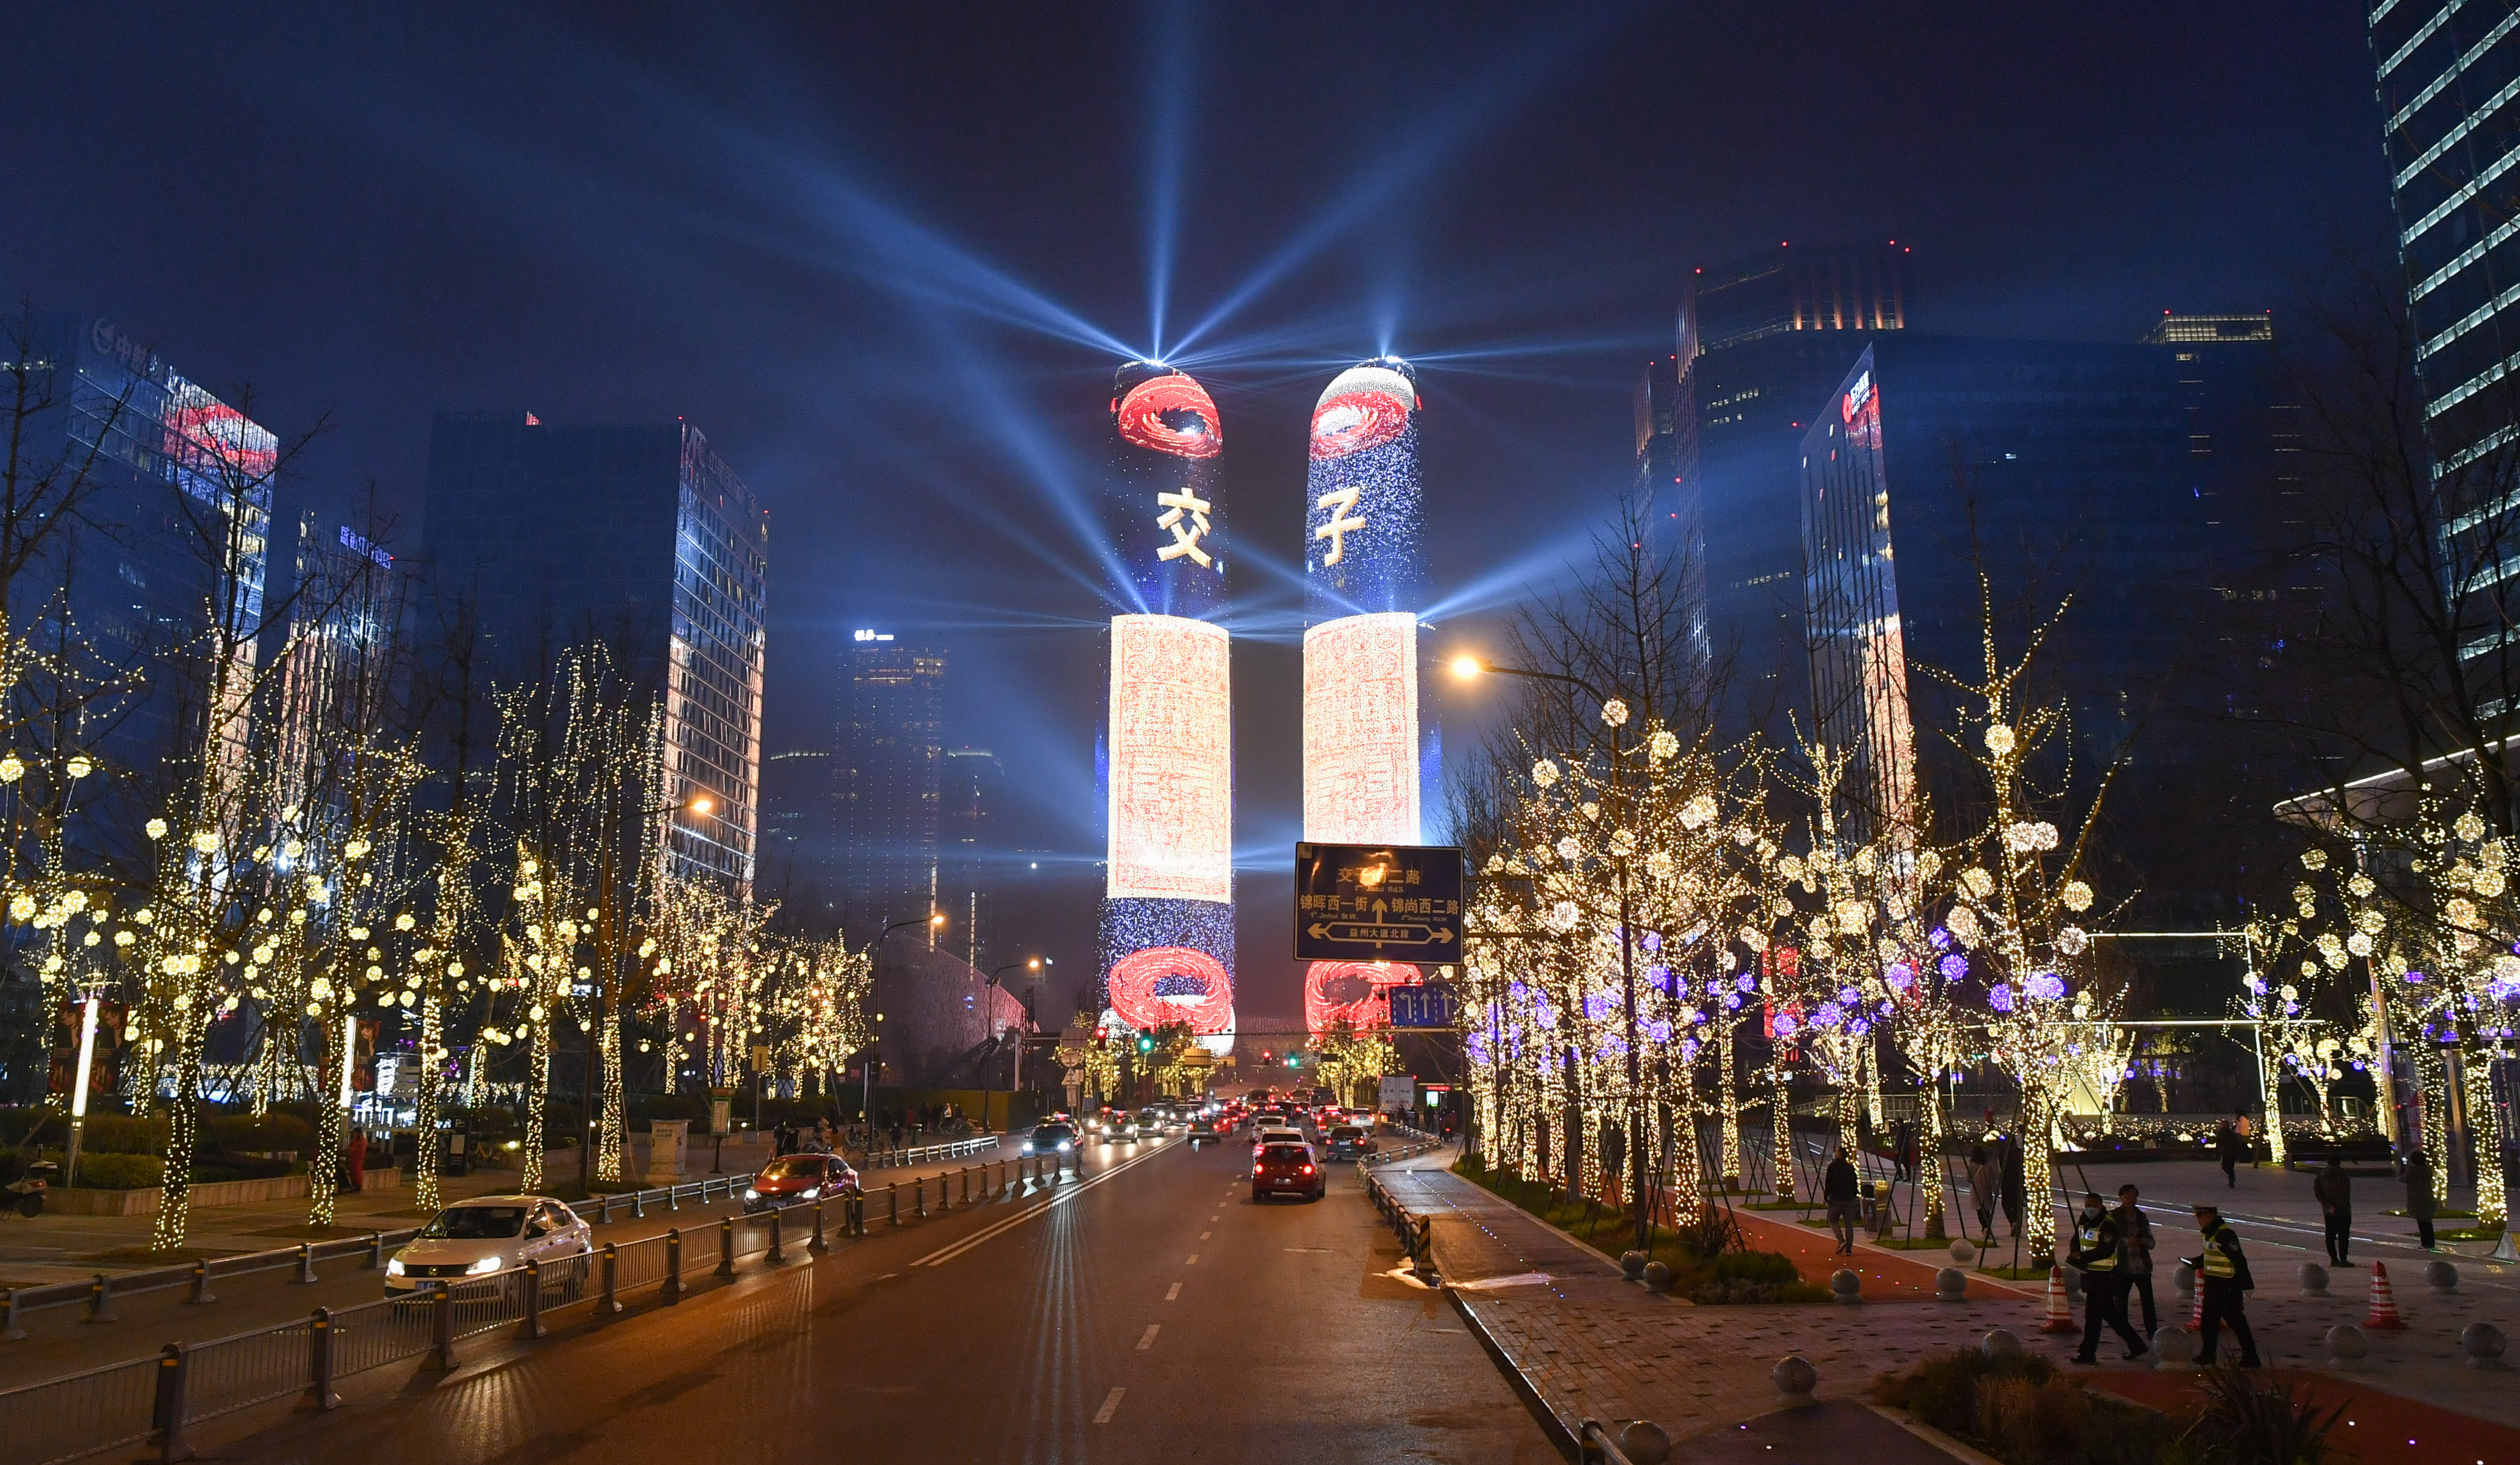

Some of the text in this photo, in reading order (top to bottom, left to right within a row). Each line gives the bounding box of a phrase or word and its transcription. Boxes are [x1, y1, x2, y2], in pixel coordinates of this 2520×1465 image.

[1157, 487, 1366, 568] 交 子
[1301, 895, 1368, 912] 锦晖西一街
[1391, 898, 1459, 915] 锦尚西二路
[1349, 927, 1409, 938] 益州大道北段
